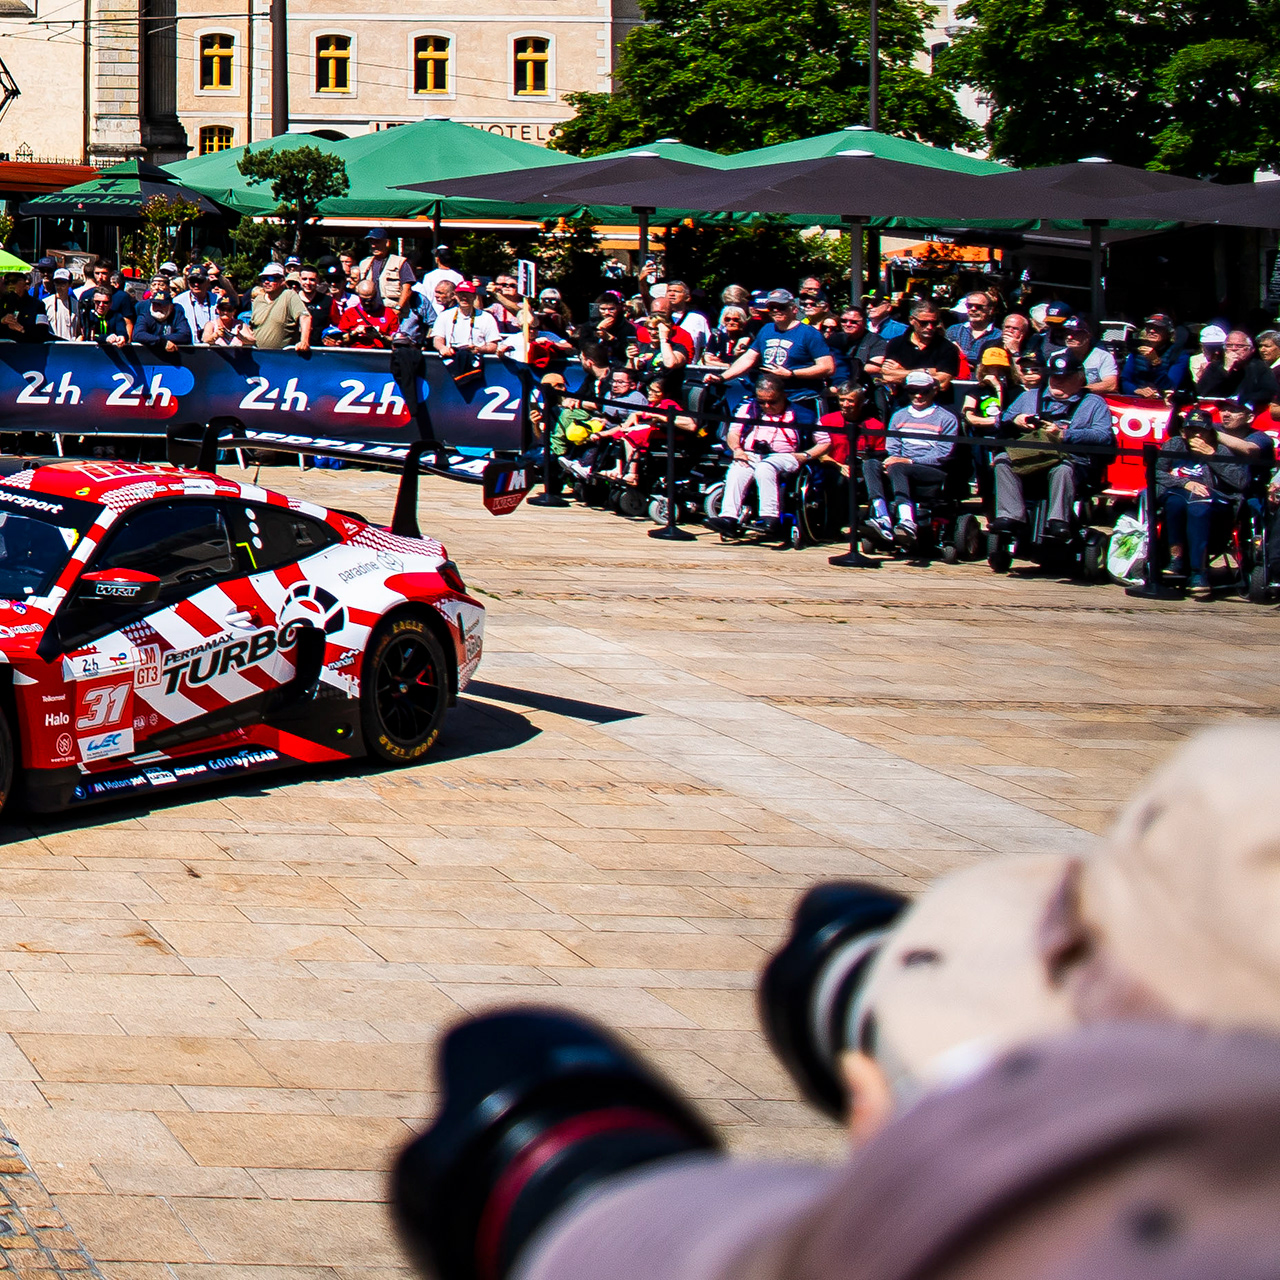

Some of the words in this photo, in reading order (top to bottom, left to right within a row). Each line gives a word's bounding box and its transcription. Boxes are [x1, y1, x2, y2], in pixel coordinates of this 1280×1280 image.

[15, 370, 82, 406] 24h
[105, 371, 173, 407] 24h
[239, 375, 308, 412] 24h
[333, 378, 407, 415] 24h
[337, 559, 380, 584] paradine
[96, 584, 141, 596] WRT
[392, 619, 425, 634] EAGLE
[139, 647, 156, 666] LM
[159, 626, 302, 696] TURBO
[163, 631, 236, 665] PERTAMAX
[137, 665, 158, 685] GT3
[44, 711, 70, 727] Halo
[75, 681, 133, 731] 31
[86, 732, 123, 752] WEC
[378, 728, 439, 760] GOODYEAR
[208, 749, 279, 770] GOODYEAR
